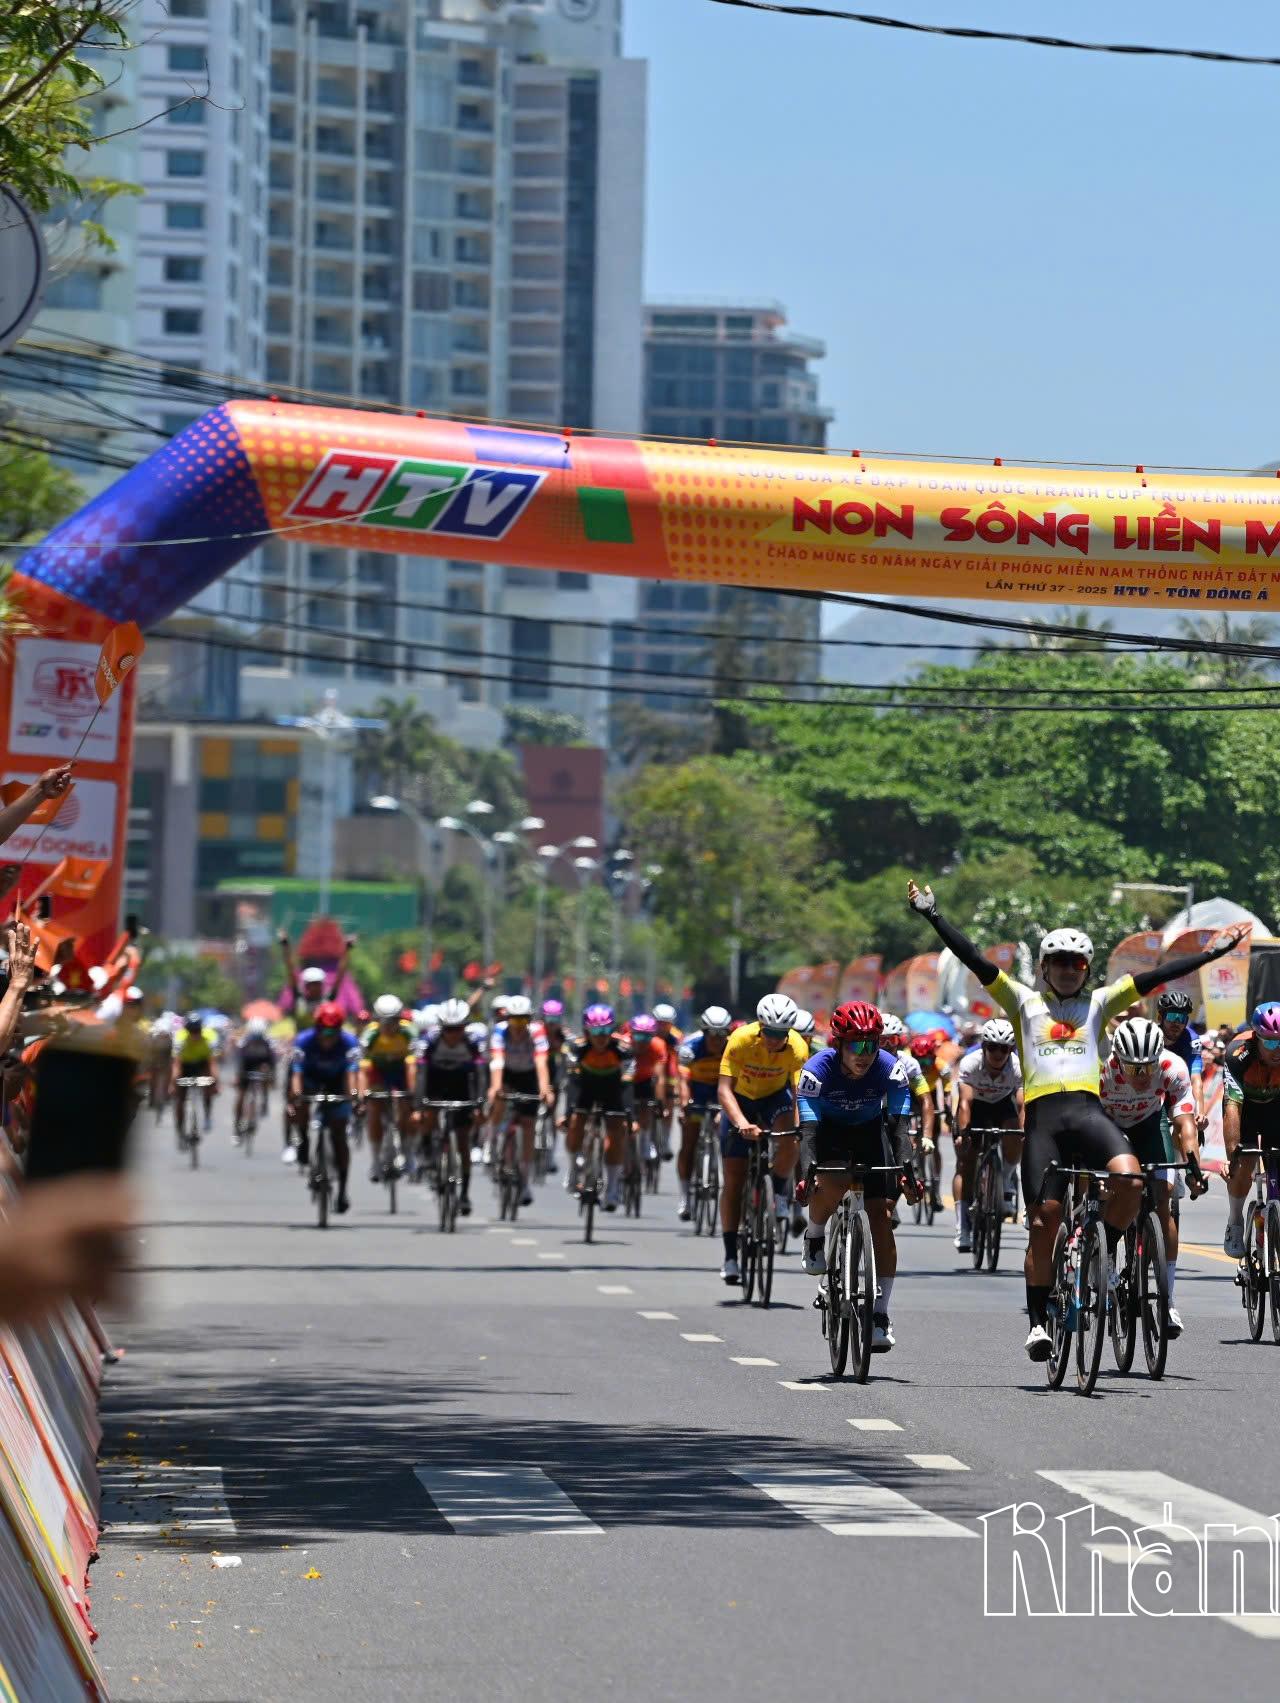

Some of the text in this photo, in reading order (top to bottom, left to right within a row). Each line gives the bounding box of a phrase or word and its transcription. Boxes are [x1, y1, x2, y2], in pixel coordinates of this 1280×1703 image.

[302, 462, 527, 528] HTV
[792, 496, 914, 540] NON
[939, 500, 1090, 556] SÔNG
[1113, 502, 1221, 555] LIỀN
[862, 553, 878, 566] 50
[1099, 565, 1133, 578] NAM
[1049, 583, 1066, 593] 37
[1077, 585, 1108, 595] 2025
[1114, 585, 1151, 597] HTV
[802, 1075, 817, 1092] 73
